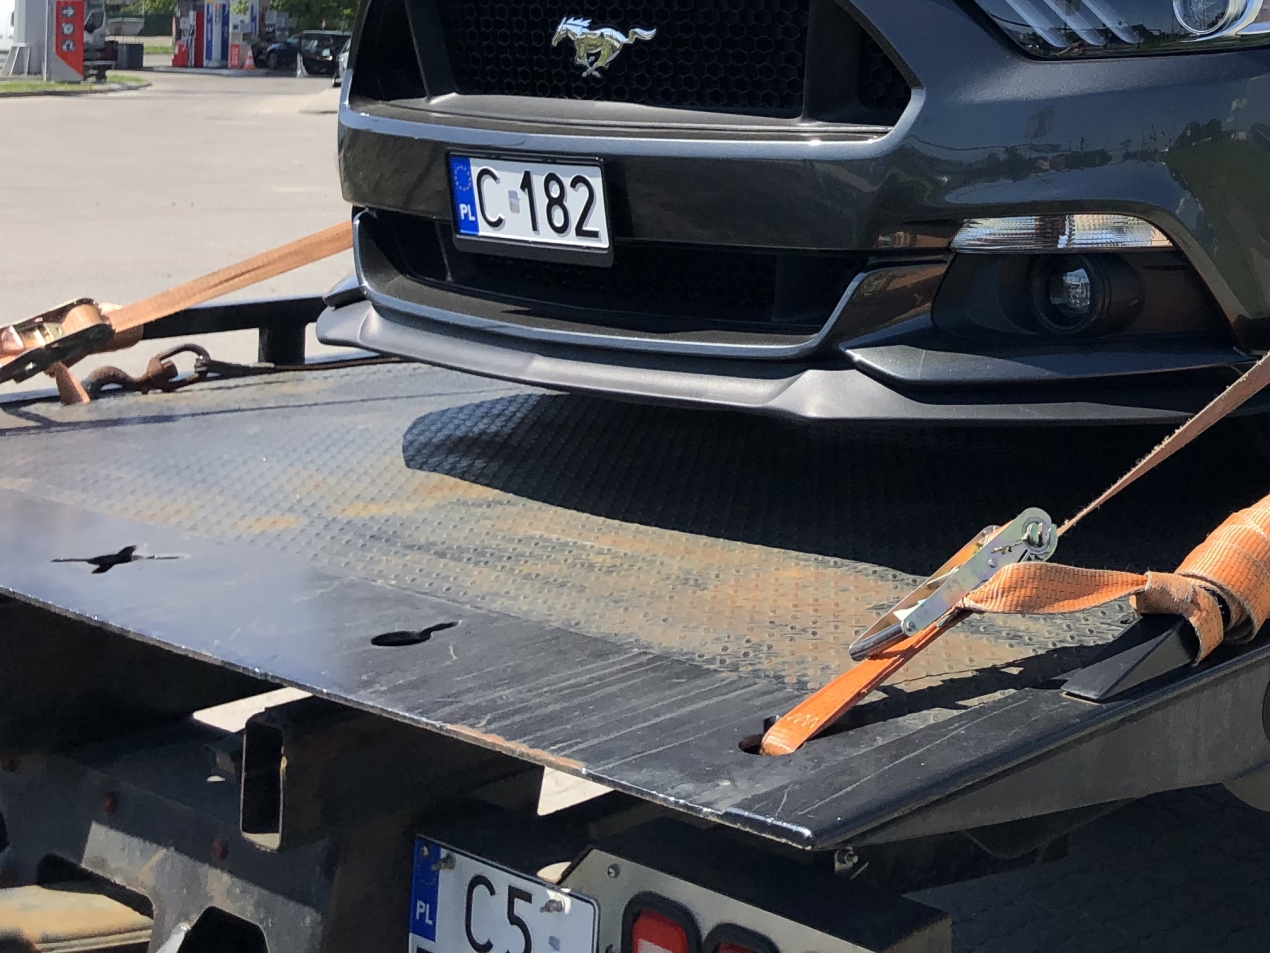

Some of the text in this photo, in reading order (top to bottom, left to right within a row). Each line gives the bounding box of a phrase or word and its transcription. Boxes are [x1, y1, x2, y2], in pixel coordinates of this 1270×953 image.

[459, 167, 600, 238] PL C 182
[415, 899, 434, 926] PL
